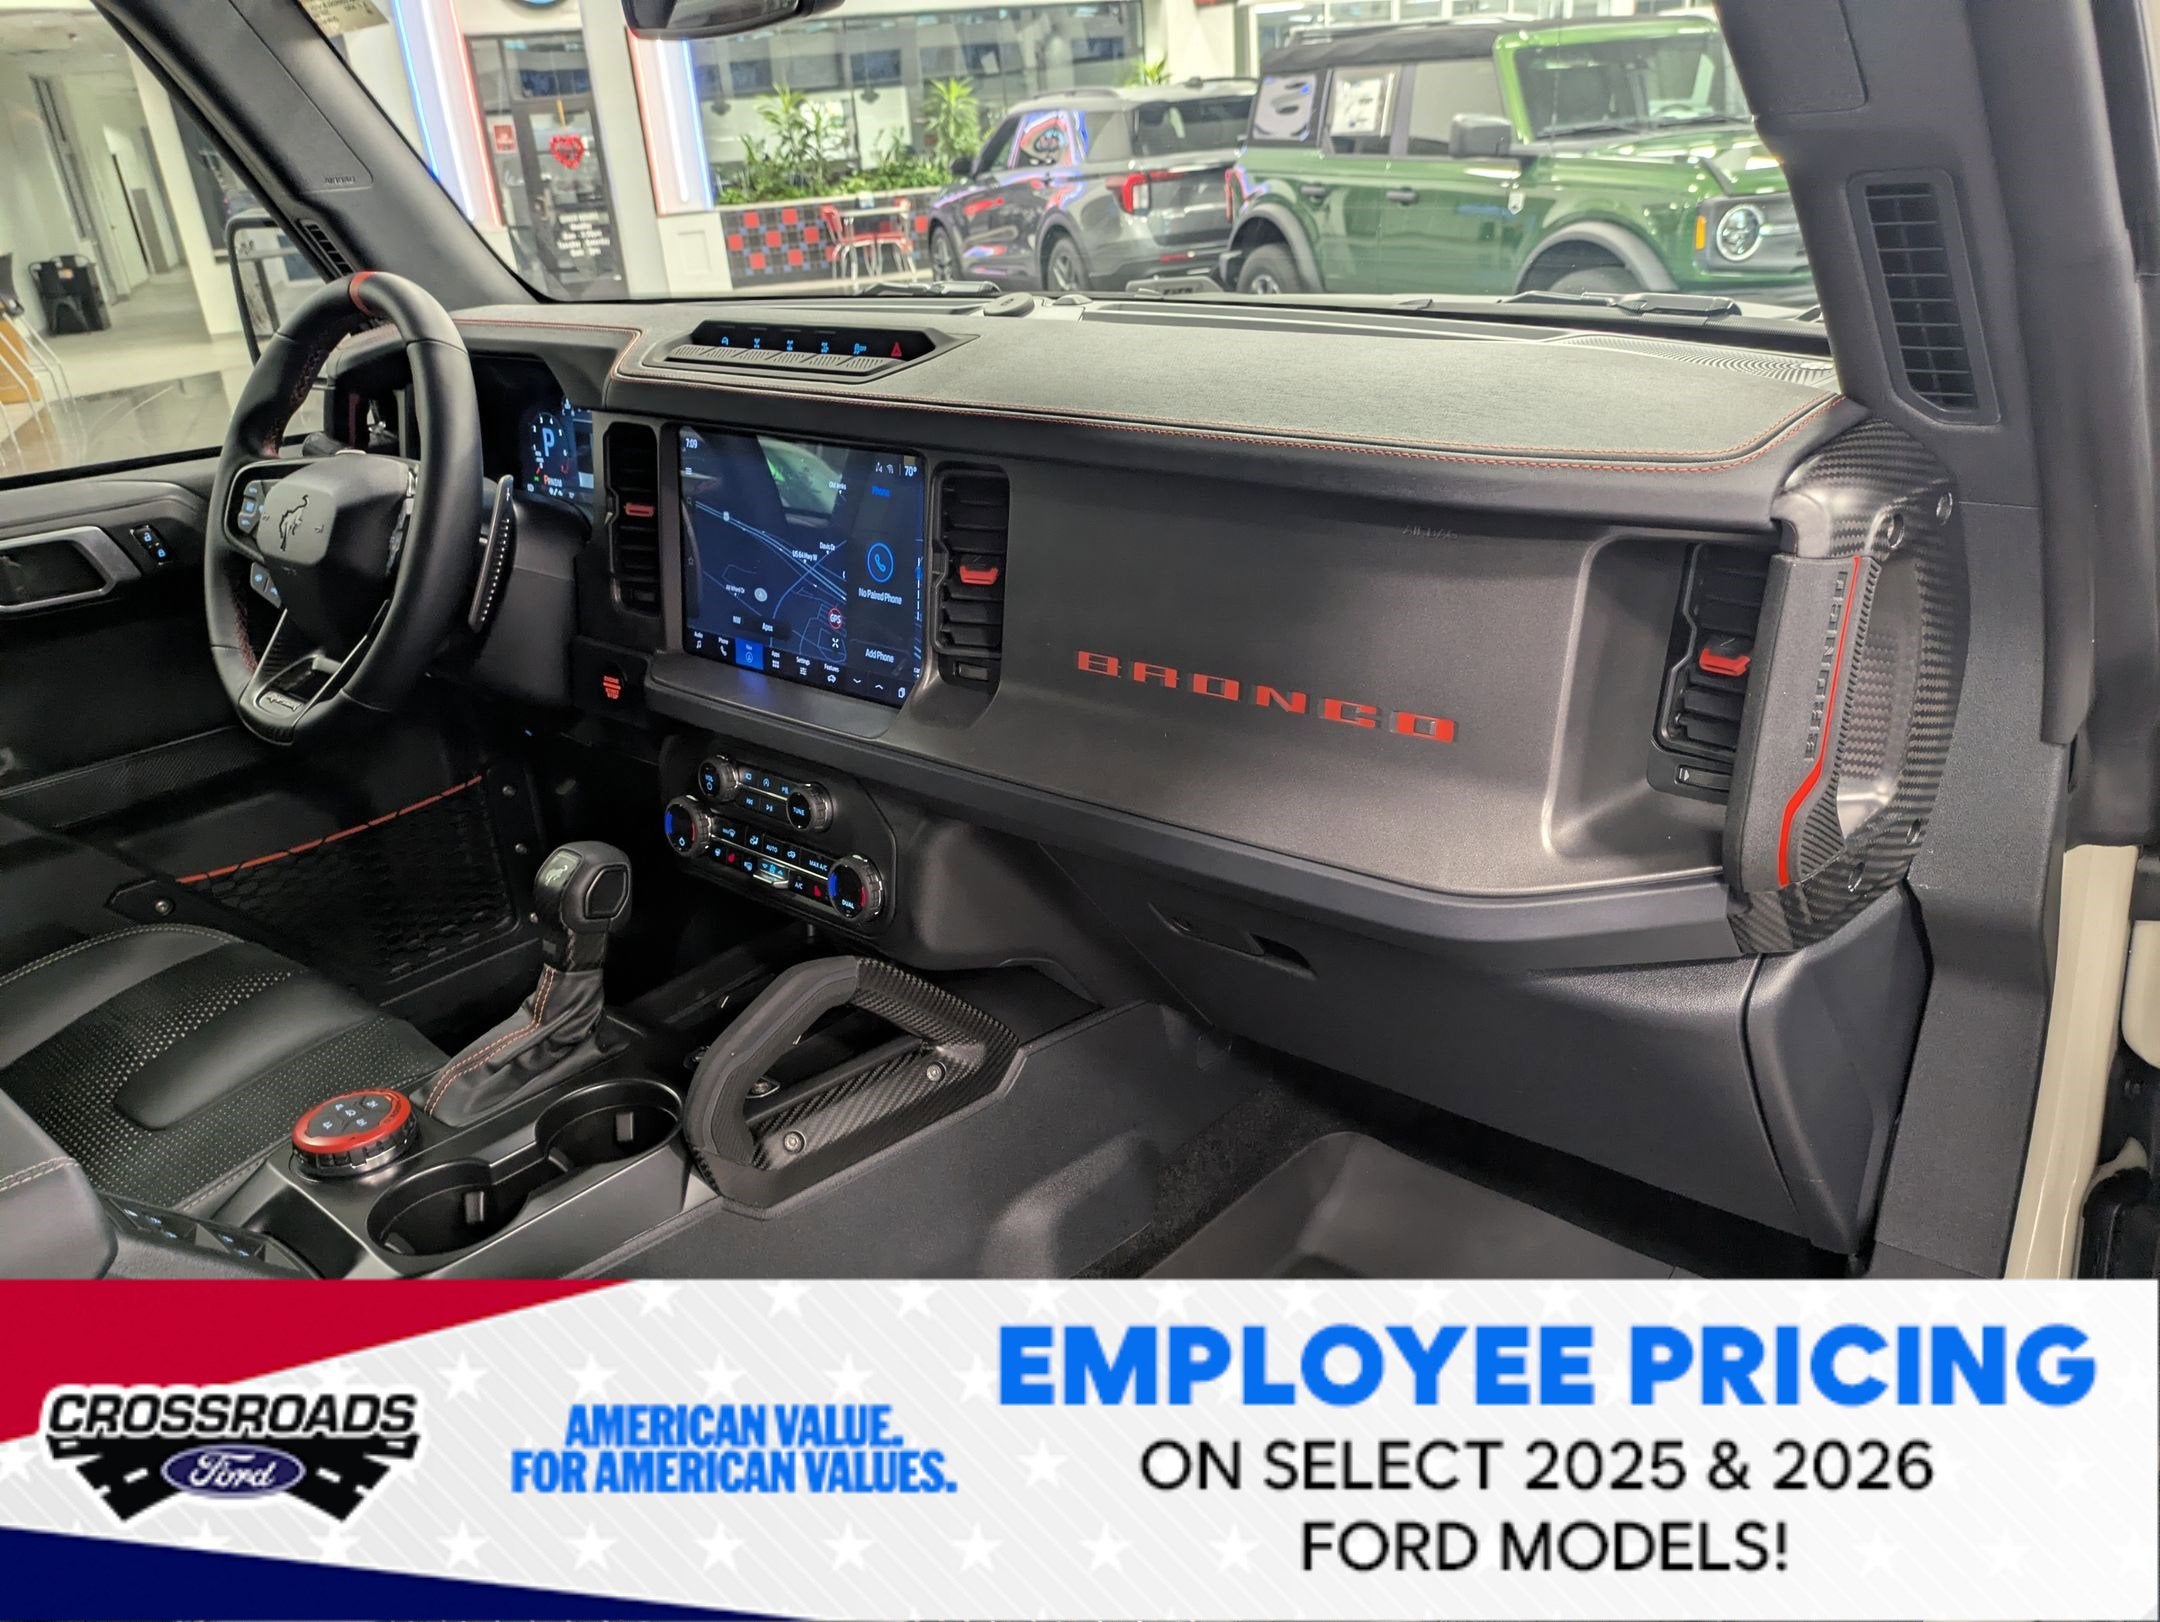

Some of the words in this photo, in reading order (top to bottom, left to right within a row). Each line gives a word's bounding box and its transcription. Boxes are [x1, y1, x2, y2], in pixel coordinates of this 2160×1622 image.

[542, 427, 555, 457] P
[858, 587, 867, 598] No
[867, 589, 884, 602] Paired
[884, 593, 903, 606] Phone
[865, 648, 877, 660] Add
[876, 651, 895, 664] Phone
[1077, 649, 1456, 744] BRONCO
